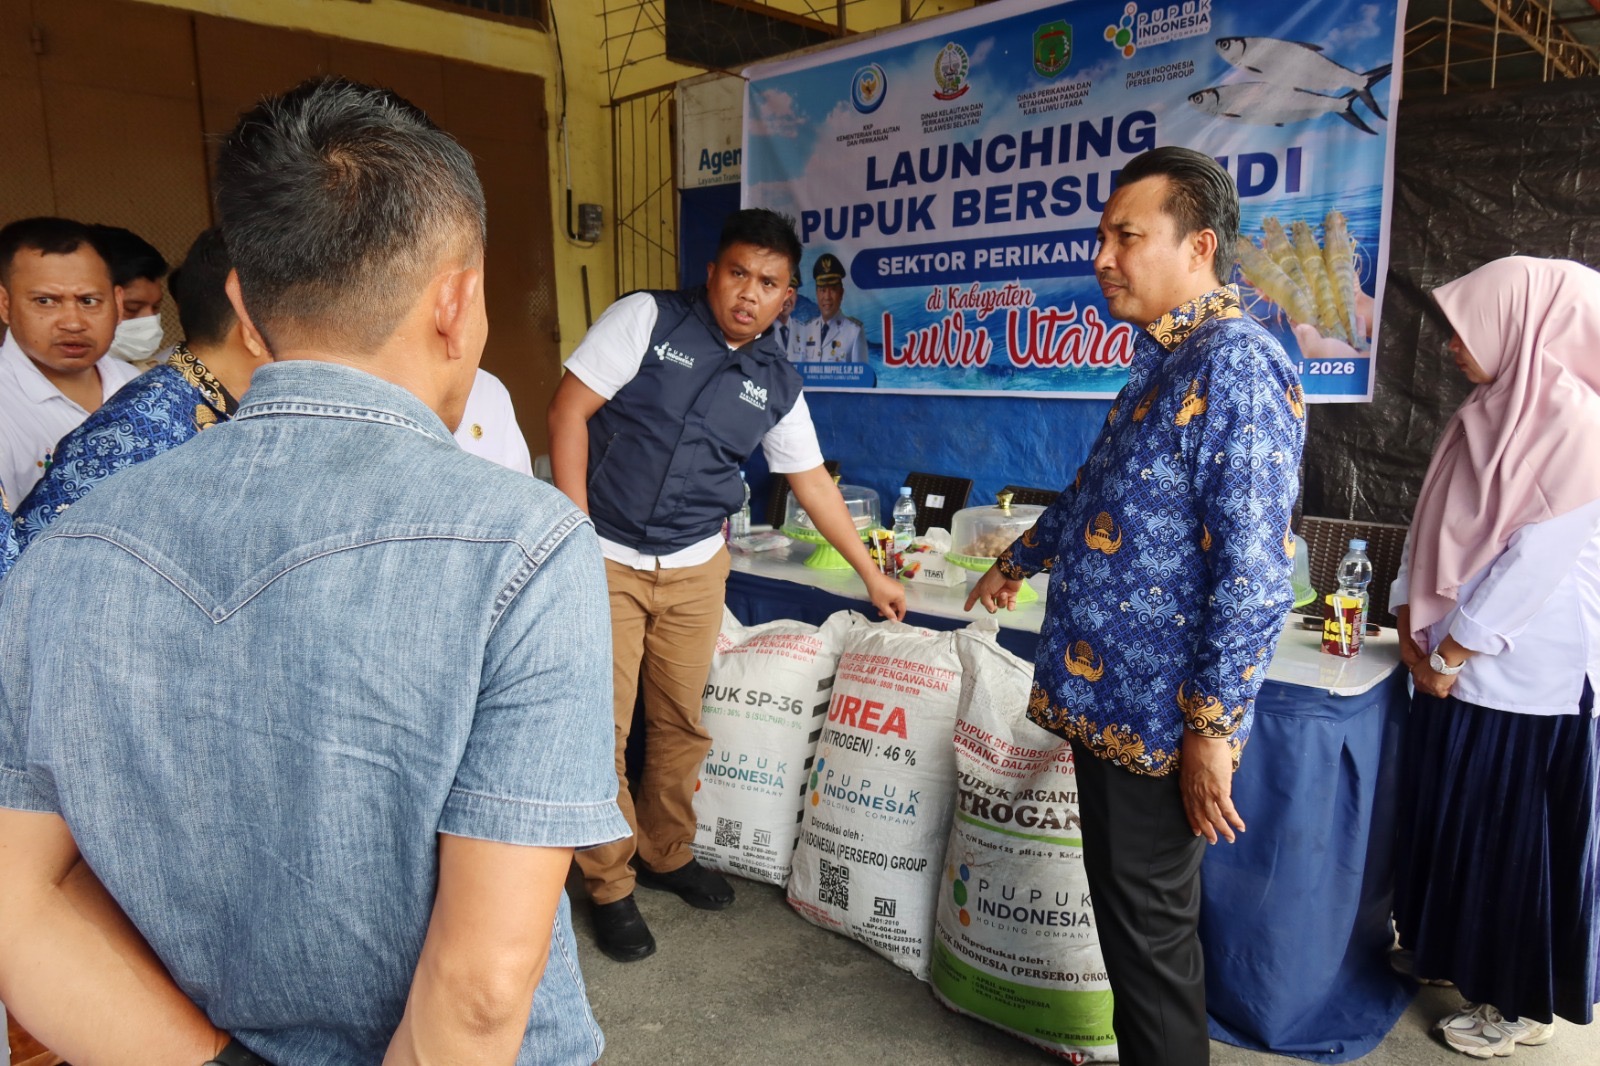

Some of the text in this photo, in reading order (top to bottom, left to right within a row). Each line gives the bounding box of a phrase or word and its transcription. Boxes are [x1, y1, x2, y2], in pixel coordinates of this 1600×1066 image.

[1138, 13, 1209, 39] INDONESIA
[1139, 2, 1210, 26] PUPUK
[1125, 68, 1195, 90] (PERSERO) GROUP
[1126, 60, 1194, 80] PUPUK INDONESIA
[1017, 81, 1092, 102] DINAS PERIKANAN DAN
[1018, 90, 1089, 109] KETAHANAN PANGAN
[921, 103, 983, 121] DINAS KELAUTAN DAN
[954, 111, 982, 121] PROVINSI
[1023, 99, 1083, 116] KAB. LUWU UTARA
[836, 125, 900, 142] KEMENTERIAN KELAUTAN
[923, 119, 980, 134] SULAWESI SELATAN
[858, 135, 889, 145] PERIKANAN
[866, 110, 1157, 191] LAUNCHING
[699, 148, 742, 175] Agen
[698, 175, 722, 186] Layanan
[801, 193, 936, 244] PUPUK
[877, 250, 968, 276] SEKTOR
[926, 279, 1035, 318] di Kabupaten
[1007, 304, 1136, 368] Utara
[1309, 361, 1355, 375] 2026
[760, 640, 817, 657] PENGAWASAN
[877, 668, 949, 692] PENGAWASAN
[891, 658, 956, 681] PEMERINTAH
[745, 690, 803, 716] SP-36
[828, 692, 908, 740] UREA
[957, 718, 993, 744] PUPUK
[820, 728, 874, 757] (NITROGEN)
[883, 745, 900, 762] 46
[905, 749, 916, 767] %
[953, 734, 999, 765] BARANG
[706, 749, 788, 775] PUPUK
[955, 746, 982, 764] NOMOR
[982, 762, 1026, 780] PENGADUAN
[704, 777, 783, 798] HOLDING COMPANY
[705, 763, 784, 789] INDONESIA
[826, 769, 921, 804] PUPUK
[957, 770, 1013, 801] PUPUK
[1014, 788, 1079, 804] ORGANI
[821, 799, 917, 826] HOLDING COMPANY
[823, 783, 917, 817] INDONESIA
[958, 788, 1082, 831] TROGAN
[752, 829, 772, 847] SNI
[811, 816, 842, 836] Diproduksi
[843, 829, 859, 841] oleh
[804, 833, 836, 856] INDONESIA
[837, 842, 888, 872] (PERSERO)
[890, 855, 928, 872] GROUP
[977, 838, 998, 850] Rasio
[1019, 848, 1031, 856] pH
[729, 861, 748, 872] BERAT
[749, 866, 773, 878] BERSIH
[978, 878, 1092, 908] PUPUK
[874, 896, 896, 918] SNI
[977, 897, 1091, 928] INDONESIA
[976, 916, 1091, 939] HOLDING COMPANY
[873, 939, 900, 954] BERSIH
[901, 945, 910, 955] 50
[911, 946, 921, 958] kg
[953, 938, 1008, 972] INDONESIA
[1011, 966, 1079, 984] (PERSERO)
[1082, 971, 1109, 982] GROU
[961, 933, 1016, 960] Diproduksi
[1018, 955, 1044, 965] oleh
[1065, 1033, 1095, 1042] BERSIH
